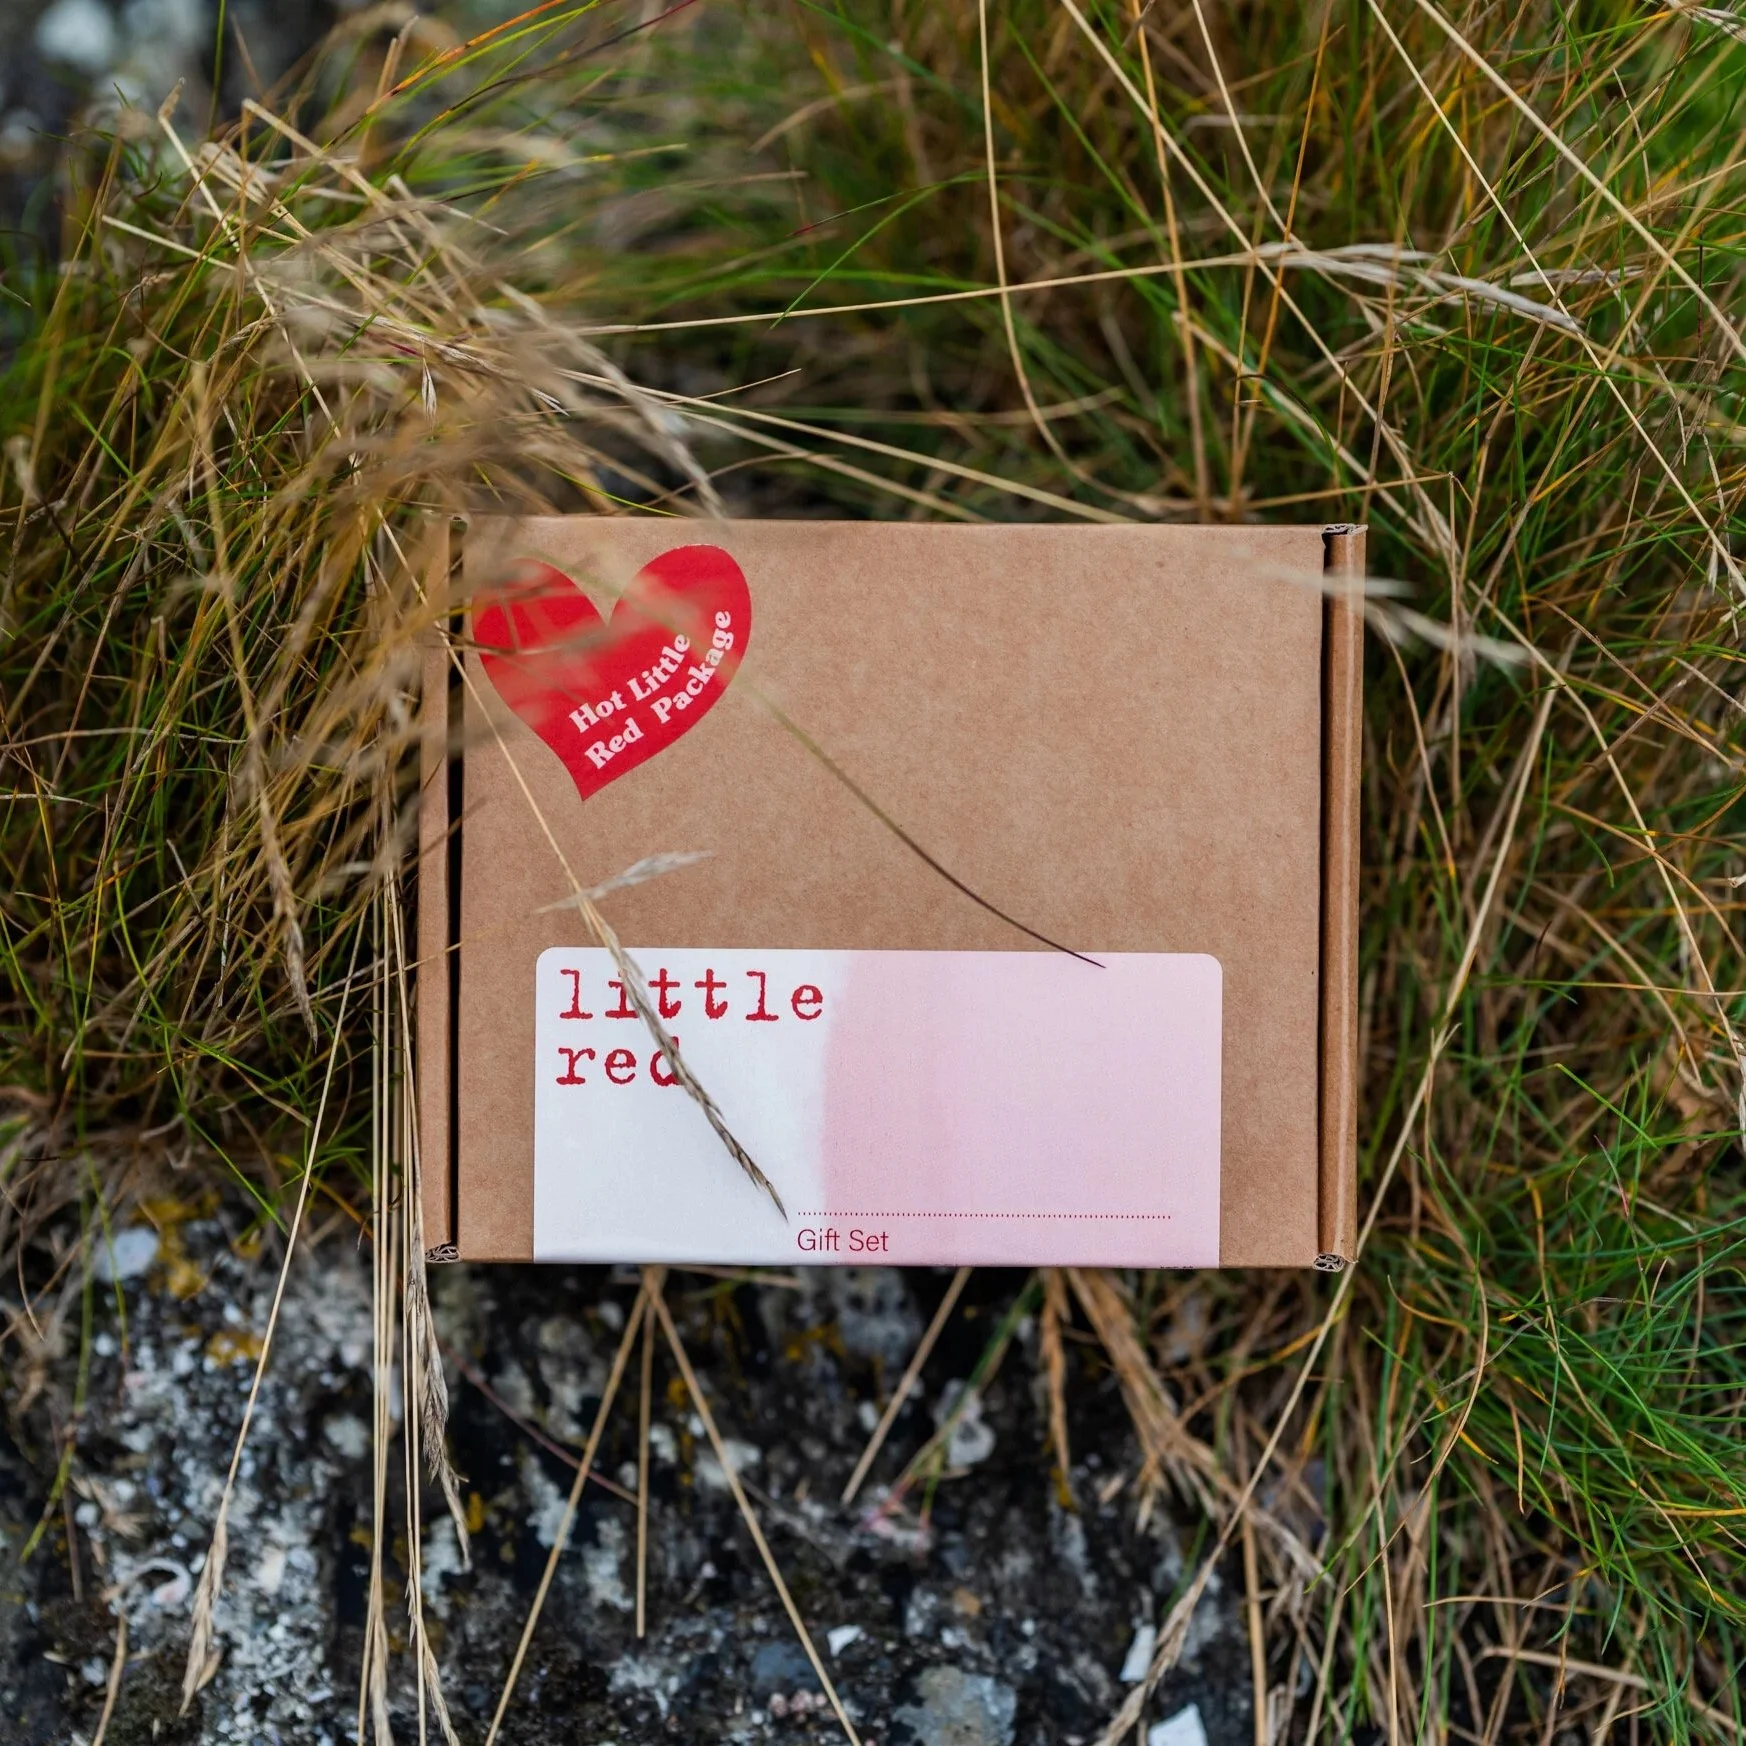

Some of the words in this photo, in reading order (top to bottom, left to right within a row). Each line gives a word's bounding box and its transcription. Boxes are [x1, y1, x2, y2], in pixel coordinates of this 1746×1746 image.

[569, 690, 628, 734] Hot
[626, 633, 691, 702] Little
[584, 717, 645, 770] Red
[650, 610, 734, 724] Package
[559, 968, 824, 1022] little
[797, 1227, 840, 1251] Gift
[849, 1229, 889, 1252] Set
